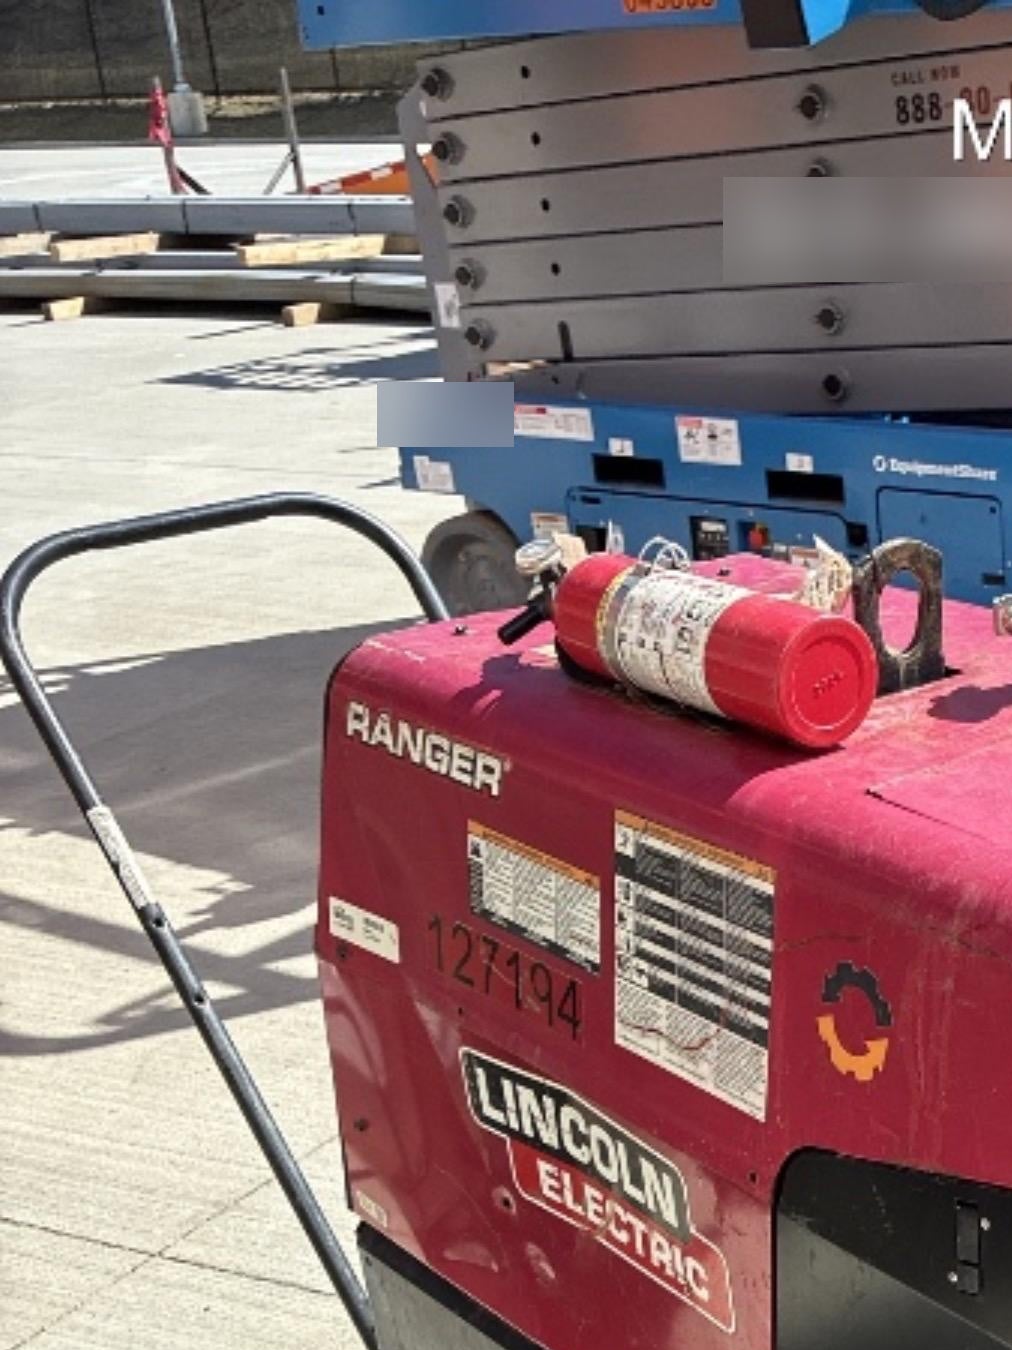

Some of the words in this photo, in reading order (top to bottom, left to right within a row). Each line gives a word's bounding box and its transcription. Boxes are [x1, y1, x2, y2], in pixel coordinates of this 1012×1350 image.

[346, 700, 504, 797] RANGER
[428, 914, 582, 1041] 127194
[474, 1065, 680, 1229] LINCOLN
[536, 1156, 710, 1302] ELECTRIC
